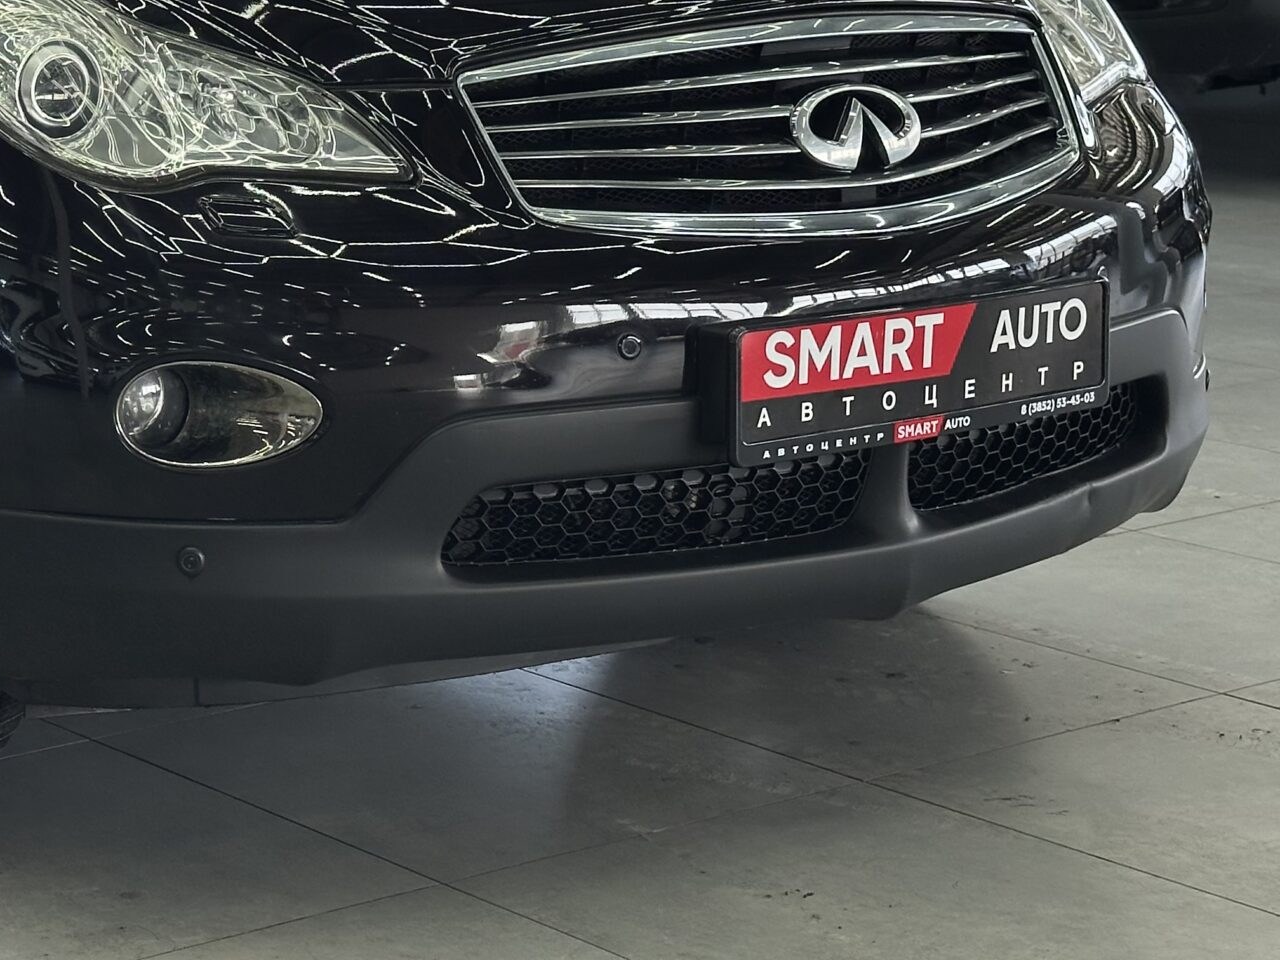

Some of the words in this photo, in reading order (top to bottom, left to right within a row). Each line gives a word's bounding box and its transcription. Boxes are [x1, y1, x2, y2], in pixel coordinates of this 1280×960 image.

[763, 312, 944, 389] SMART
[990, 298, 1088, 353] AUTO
[756, 361, 1084, 428] АВТОЦЕНТР
[1020, 403, 1027, 415] 8
[1028, 399, 1055, 416] (3852)
[1056, 391, 1096, 409] 53-43-03
[762, 432, 885, 459] АВТОЦЕНТР
[897, 420, 939, 439] SMART
[944, 416, 971, 431] AUTO
